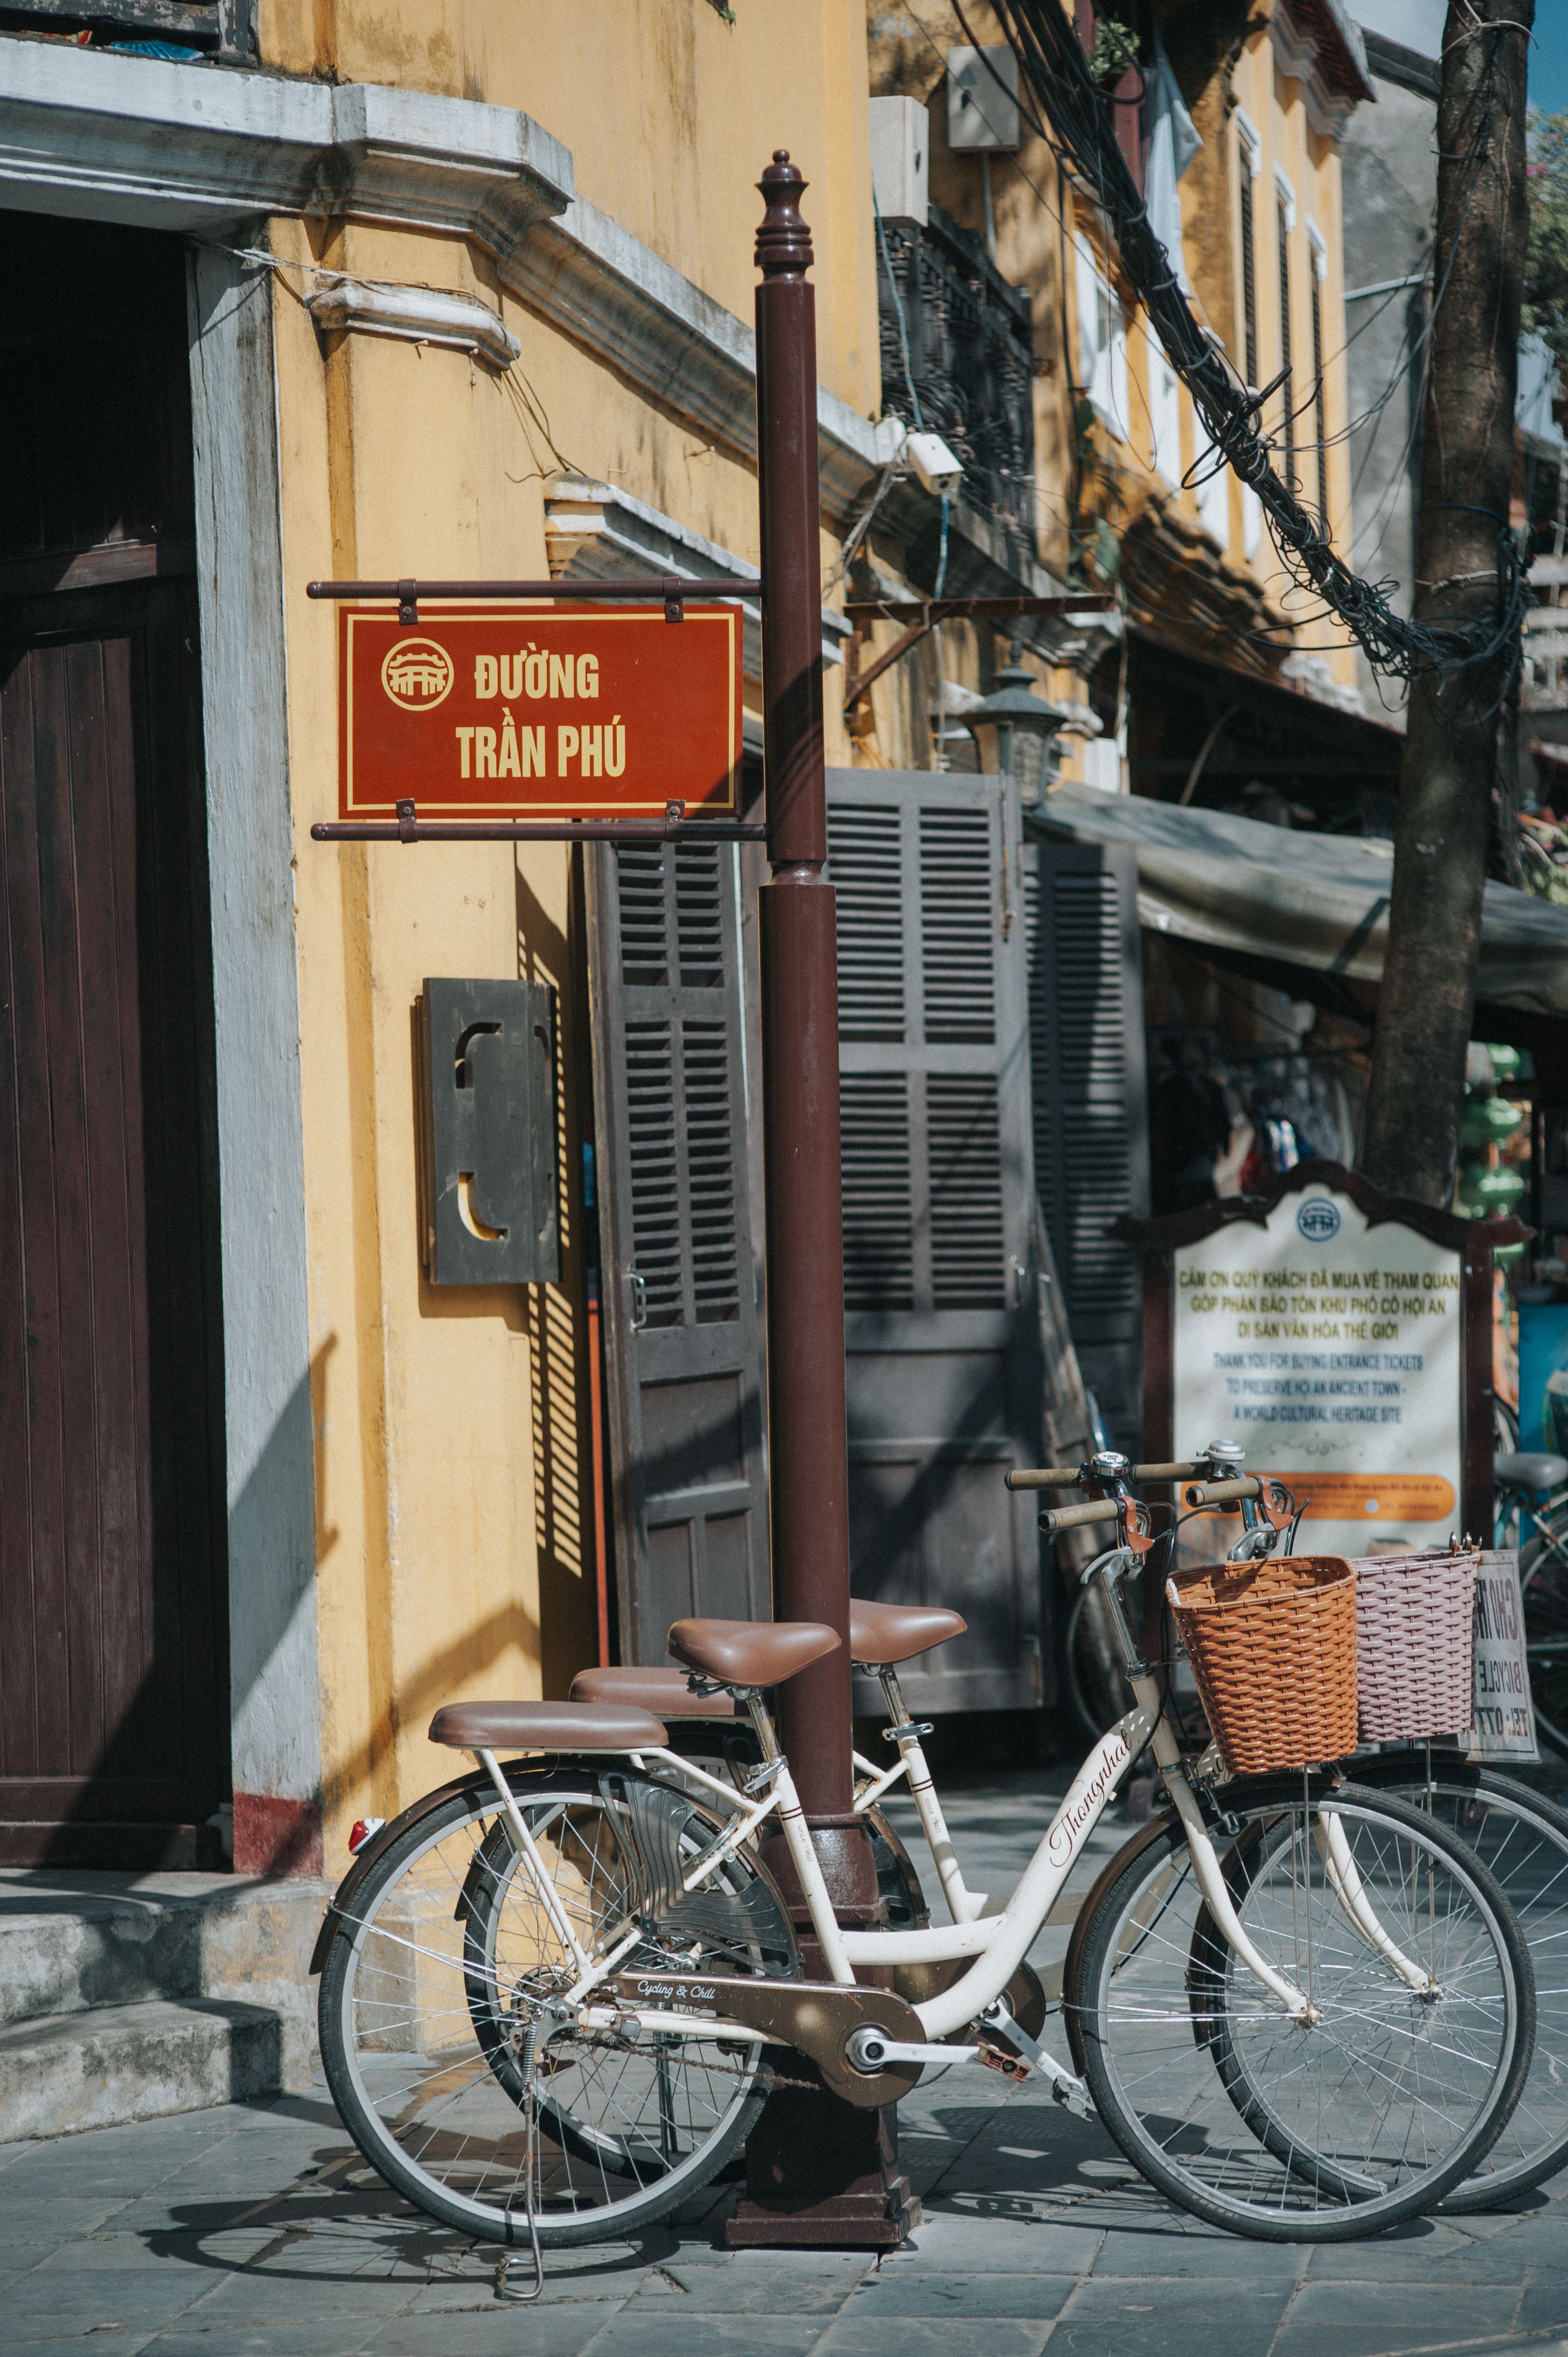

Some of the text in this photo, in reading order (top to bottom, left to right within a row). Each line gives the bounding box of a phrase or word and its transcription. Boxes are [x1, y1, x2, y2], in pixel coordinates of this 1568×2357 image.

[474, 642, 599, 699] ĐƯỜNG
[456, 707, 626, 779] TRẦN PHÚ
[1332, 1272, 1360, 1289] MUA
[1384, 1272, 1420, 1290] THAM
[1423, 1272, 1459, 1291] QUAN
[1321, 1296, 1347, 1313] KHU
[1428, 1297, 1446, 1315] AN
[1329, 1353, 1381, 1370] ENTRANCE
[1384, 1354, 1423, 1371] TICKETS
[1372, 1380, 1400, 1397] TOWN
[1332, 1406, 1378, 1423] HERITAGE
[1381, 1407, 1401, 1423] SITE
[797, 1825, 813, 1862] since 1960
[637, 1980, 716, 1999] Cycling & Chill
